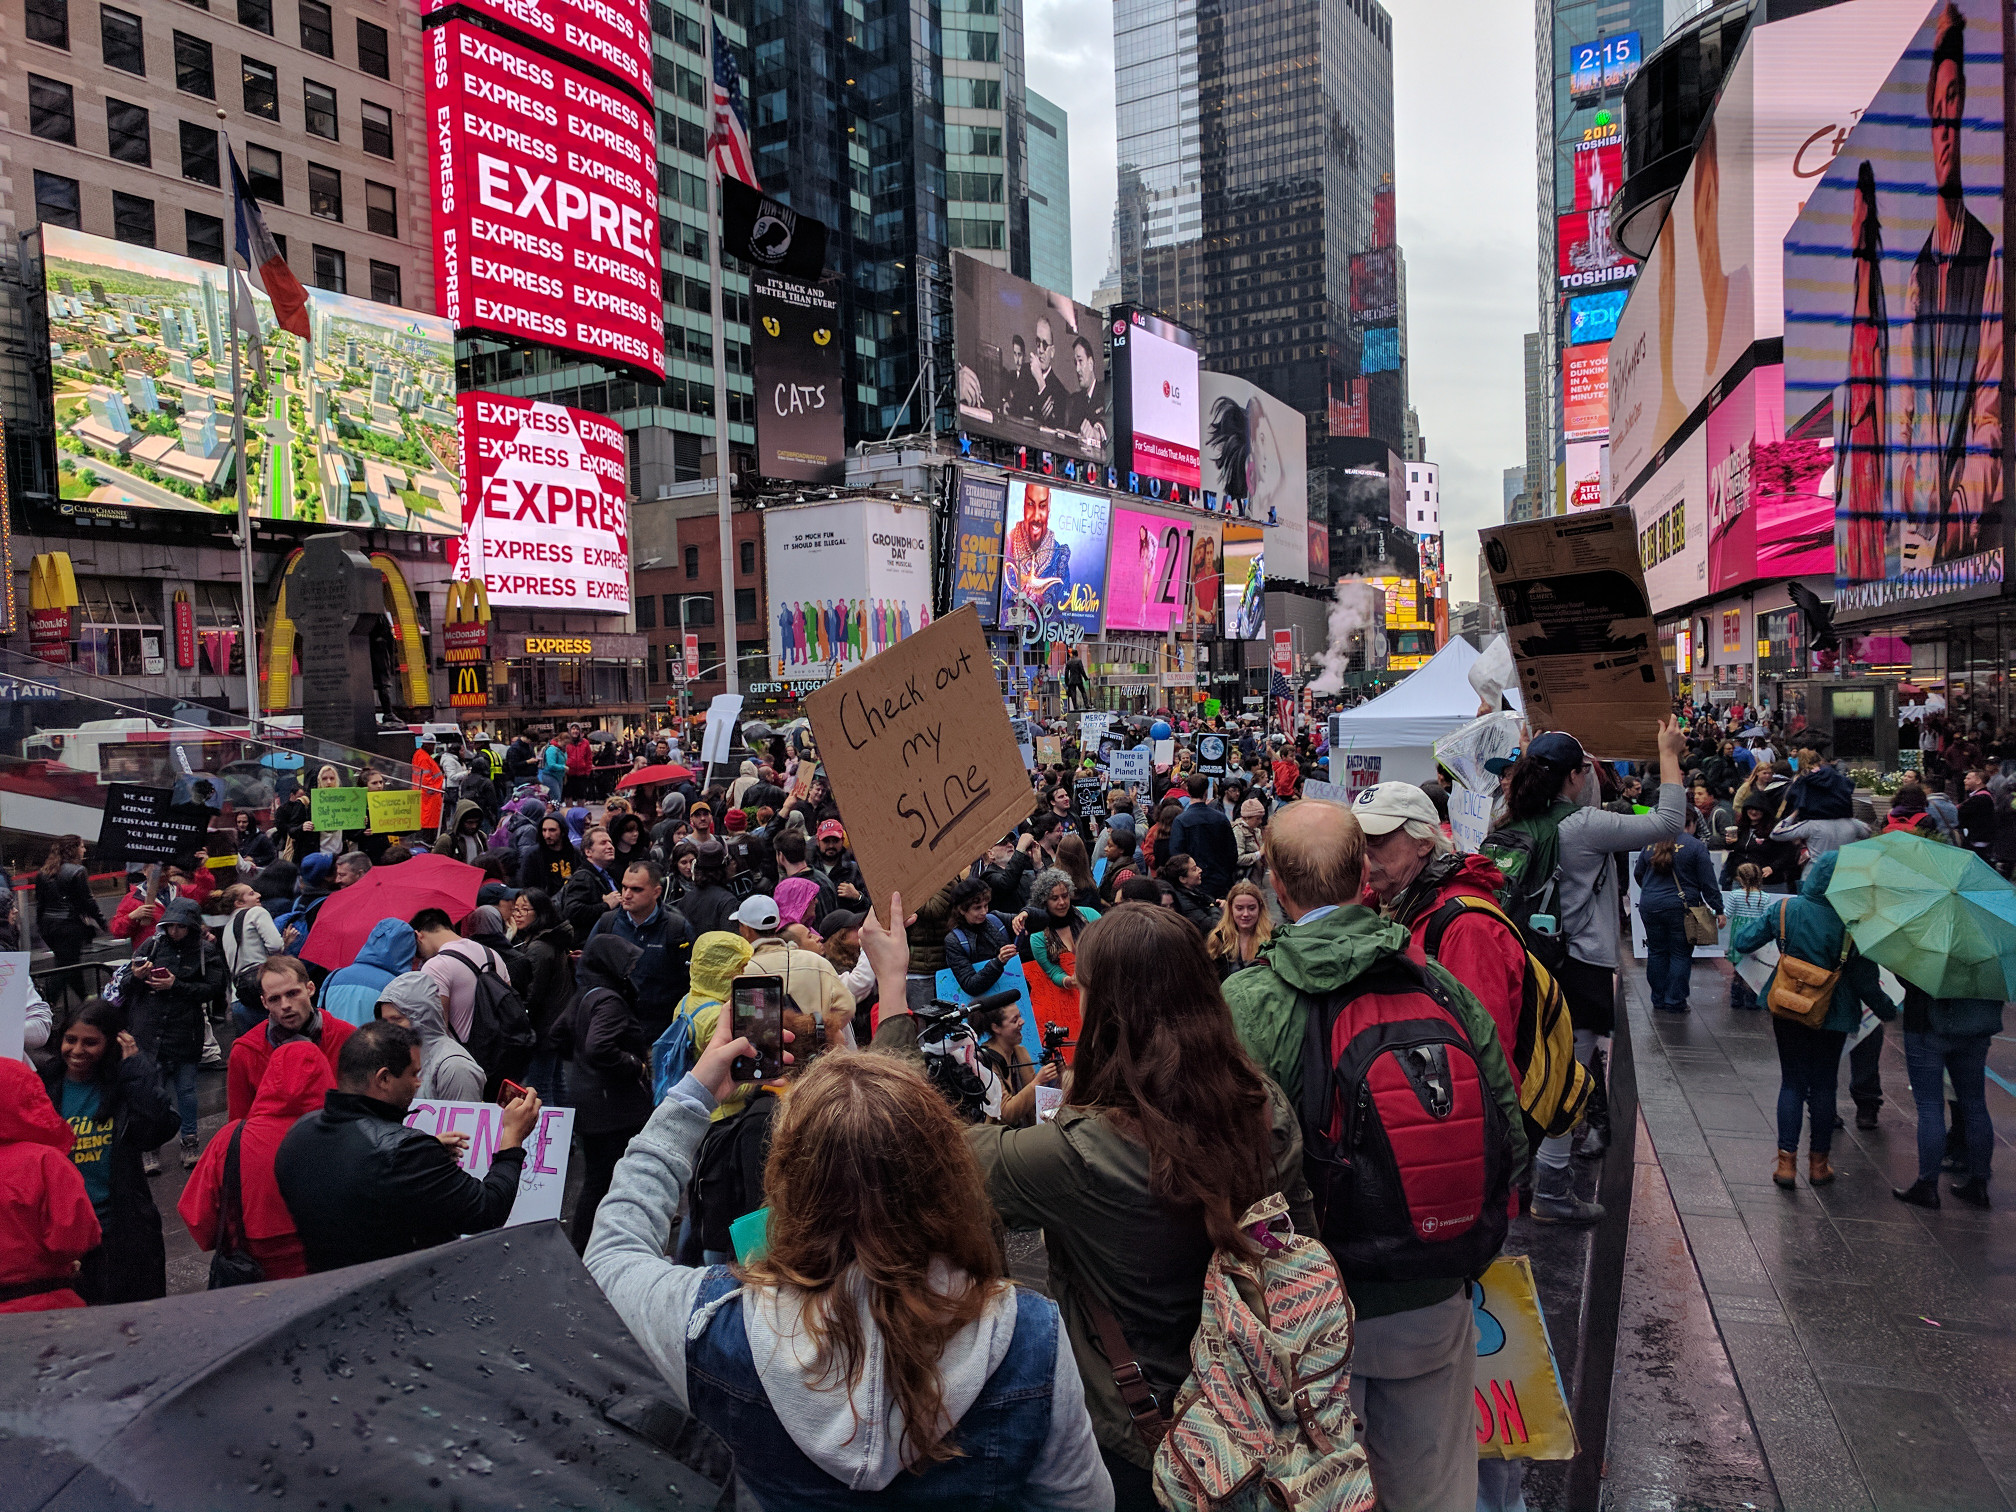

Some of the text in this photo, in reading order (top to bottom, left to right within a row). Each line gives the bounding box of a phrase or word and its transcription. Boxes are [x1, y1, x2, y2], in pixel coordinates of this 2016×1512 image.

[565, 23, 639, 79] EXPRESS
[1580, 39, 1631, 70] 2:15
[460, 33, 554, 90] EXPRESS
[564, 78, 639, 130] EXPRESS
[464, 72, 558, 127] EXPRESS
[568, 114, 642, 164] EXPRESS
[1584, 124, 1618, 141] 2017
[437, 105, 455, 214] EXPRESS
[464, 112, 642, 198] EXPRESS EXPRESS
[471, 217, 564, 262] EXPRESS
[574, 249, 647, 290] EXPRESS
[1559, 264, 1637, 288] TOSHIBA
[471, 256, 564, 298] EXPRESS
[573, 285, 647, 324] EXPRESS
[785, 282, 805, 294] BACK
[807, 288, 824, 298] AND
[789, 292, 812, 304] THAN
[475, 297, 567, 337] EXPRESS
[577, 323, 649, 360] EXPRESS
[1114, 337, 1126, 346] LG
[1570, 358, 1608, 369] GET YOU
[1570, 367, 1607, 377] DUNKIN'
[1171, 386, 1180, 399] LG
[1570, 382, 1609, 393] NEW YO
[1570, 391, 1607, 401] MINUTE.
[774, 382, 825, 417] CATS
[477, 401, 569, 435] EXPRESS
[479, 438, 569, 468] EXPRESS
[1135, 440, 1143, 451] For
[1143, 443, 1156, 455] Small
[1155, 445, 1169, 458] Loads
[1168, 448, 1178, 459] That
[1178, 451, 1186, 461] Are
[1186, 453, 1190, 463] A
[1580, 485, 1600, 493] STEL
[1580, 493, 1600, 501] ART
[457, 522, 470, 581] EXPR
[484, 539, 572, 563] EXPRESS
[791, 542, 812, 550] SHOULD
[872, 533, 925, 550] GROUNDHOG
[960, 533, 999, 555] COME
[891, 549, 907, 559] DAY
[895, 560, 912, 568] MUSICAL
[1154, 525, 1194, 605] 21
[485, 575, 576, 597] EXPRESS
[957, 572, 997, 592] AWAY
[1834, 581, 1884, 614] AMERICAN
[1915, 547, 2004, 600] OUTFITTERS
[1058, 583, 1100, 611] Aladdin
[445, 629, 486, 640] McDonald's
[526, 638, 592, 654] EXPRESS
[21, 684, 56, 697] ATM
[750, 681, 827, 693] GIFTS LUGGA
[840, 648, 972, 750] Check out
[902, 722, 942, 767] my
[319, 790, 346, 804] Science
[121, 805, 156, 815] SCIENCE.
[112, 817, 160, 828] RESISTANCE
[145, 832, 165, 840] WILL
[405, 1103, 564, 1175] CIENE
[75, 1149, 104, 1164] DAY
